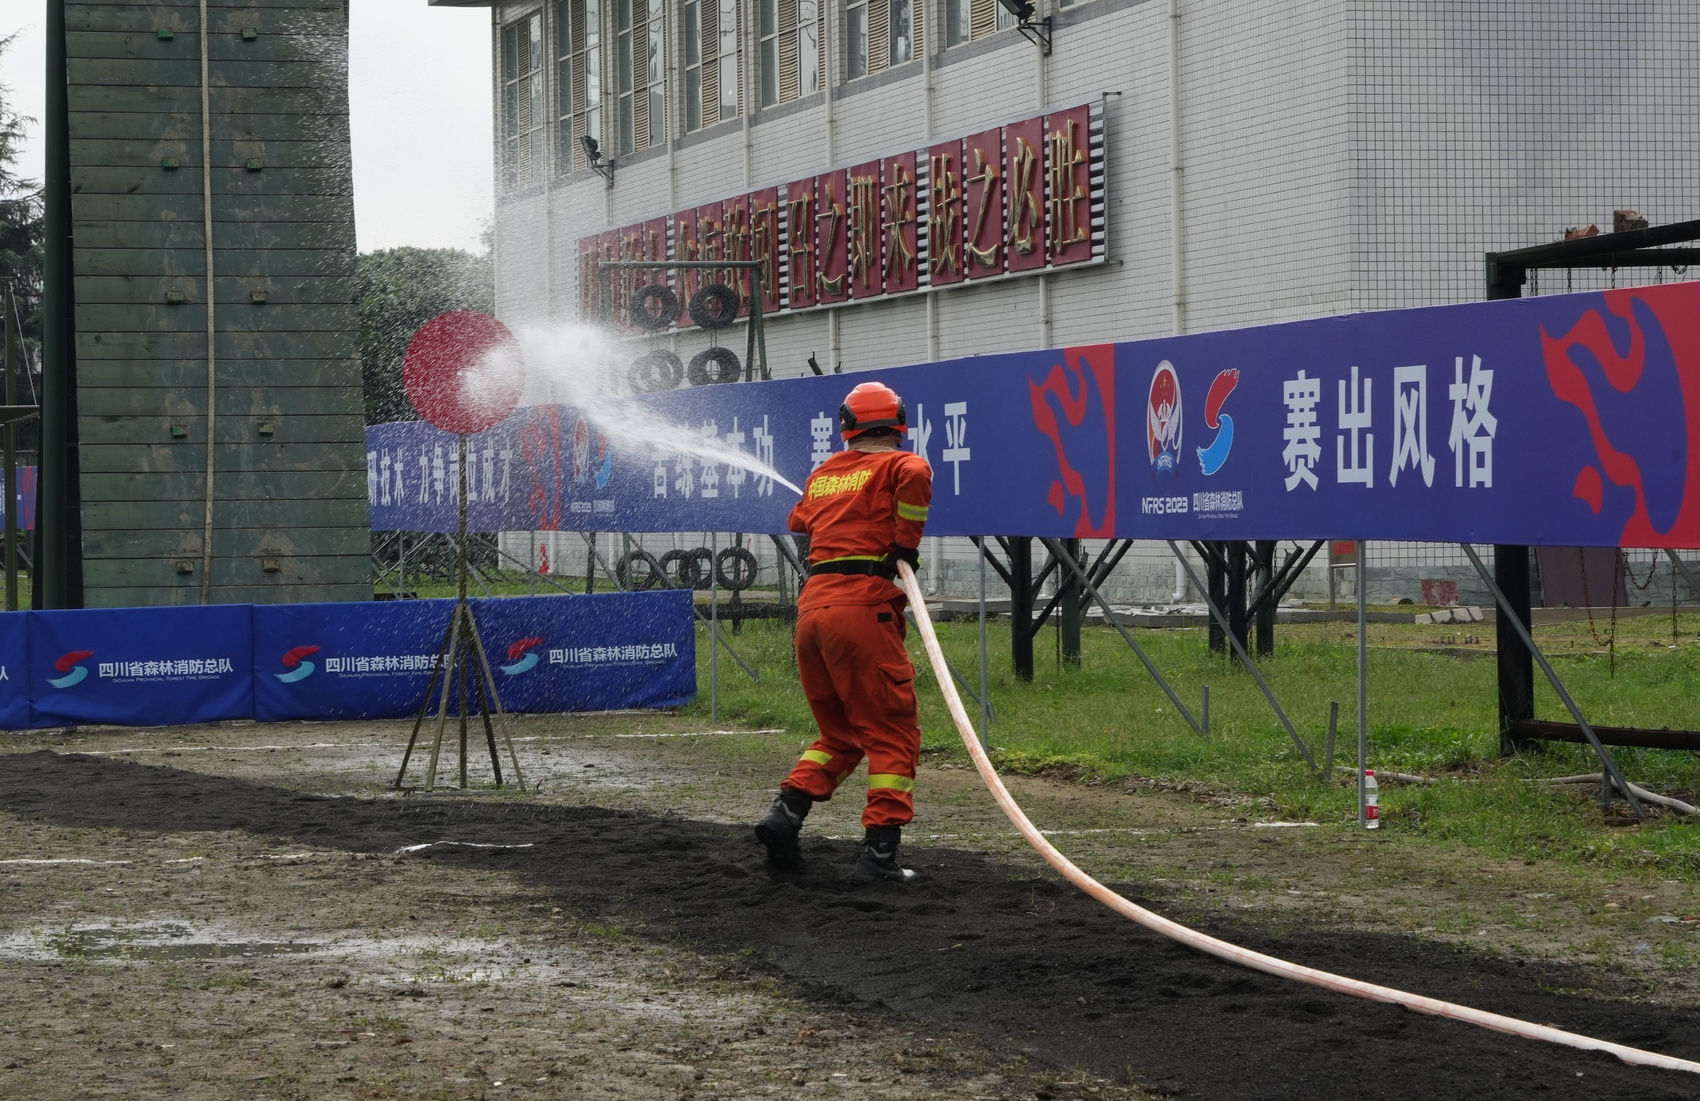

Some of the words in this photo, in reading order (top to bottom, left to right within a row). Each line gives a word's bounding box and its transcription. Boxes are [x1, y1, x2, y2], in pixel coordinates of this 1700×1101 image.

[1282, 354, 1498, 492] 赛出风格
[811, 401, 971, 496] 赛水平
[1157, 454, 1173, 469] NFRS
[1142, 497, 1165, 514] NFRS
[1166, 497, 1189, 513] 2023
[1193, 490, 1243, 512] 四川省森林消防总队
[549, 643, 678, 664] 四川省森林消防总队
[98, 658, 234, 678] 四川省森林消防总队
